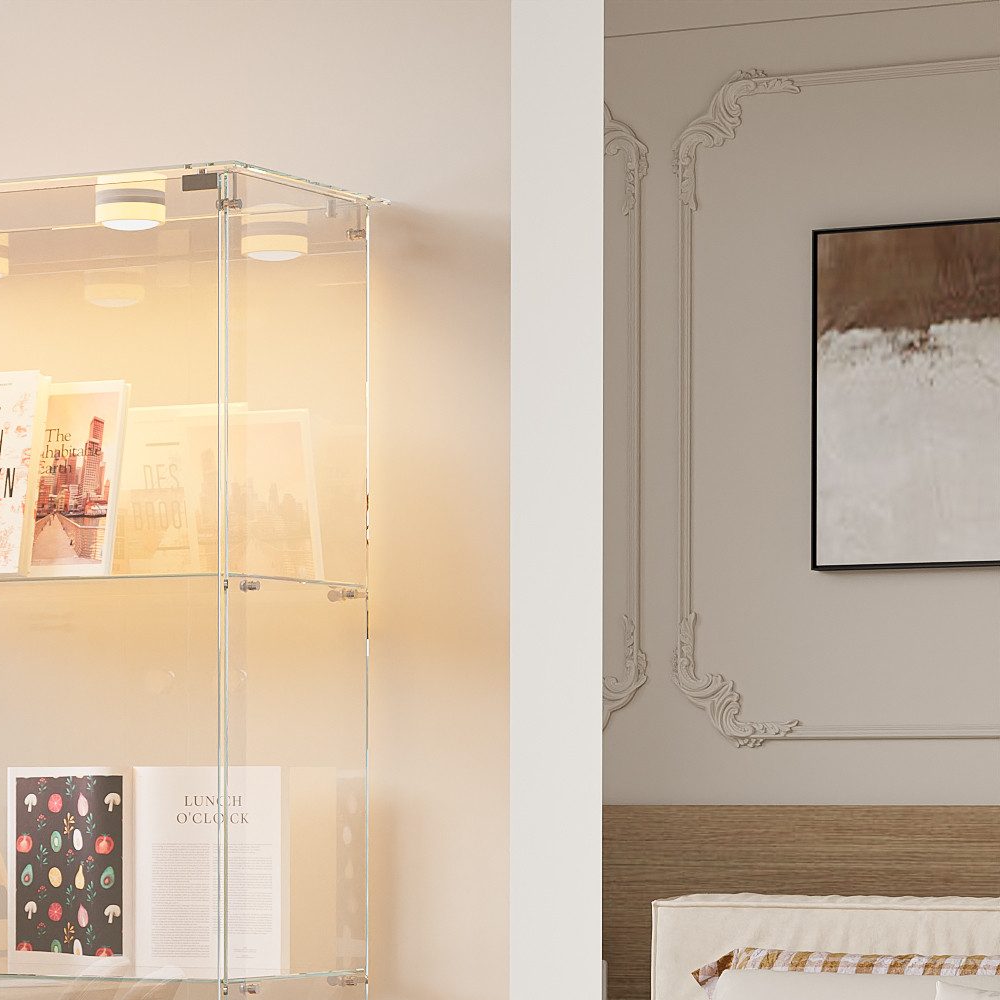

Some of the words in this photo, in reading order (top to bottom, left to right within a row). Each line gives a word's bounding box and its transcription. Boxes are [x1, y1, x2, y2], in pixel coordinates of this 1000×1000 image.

[45, 428, 72, 443] The
[184, 795, 242, 807] LUNCH
[176, 812, 249, 824] O'CLOCK
